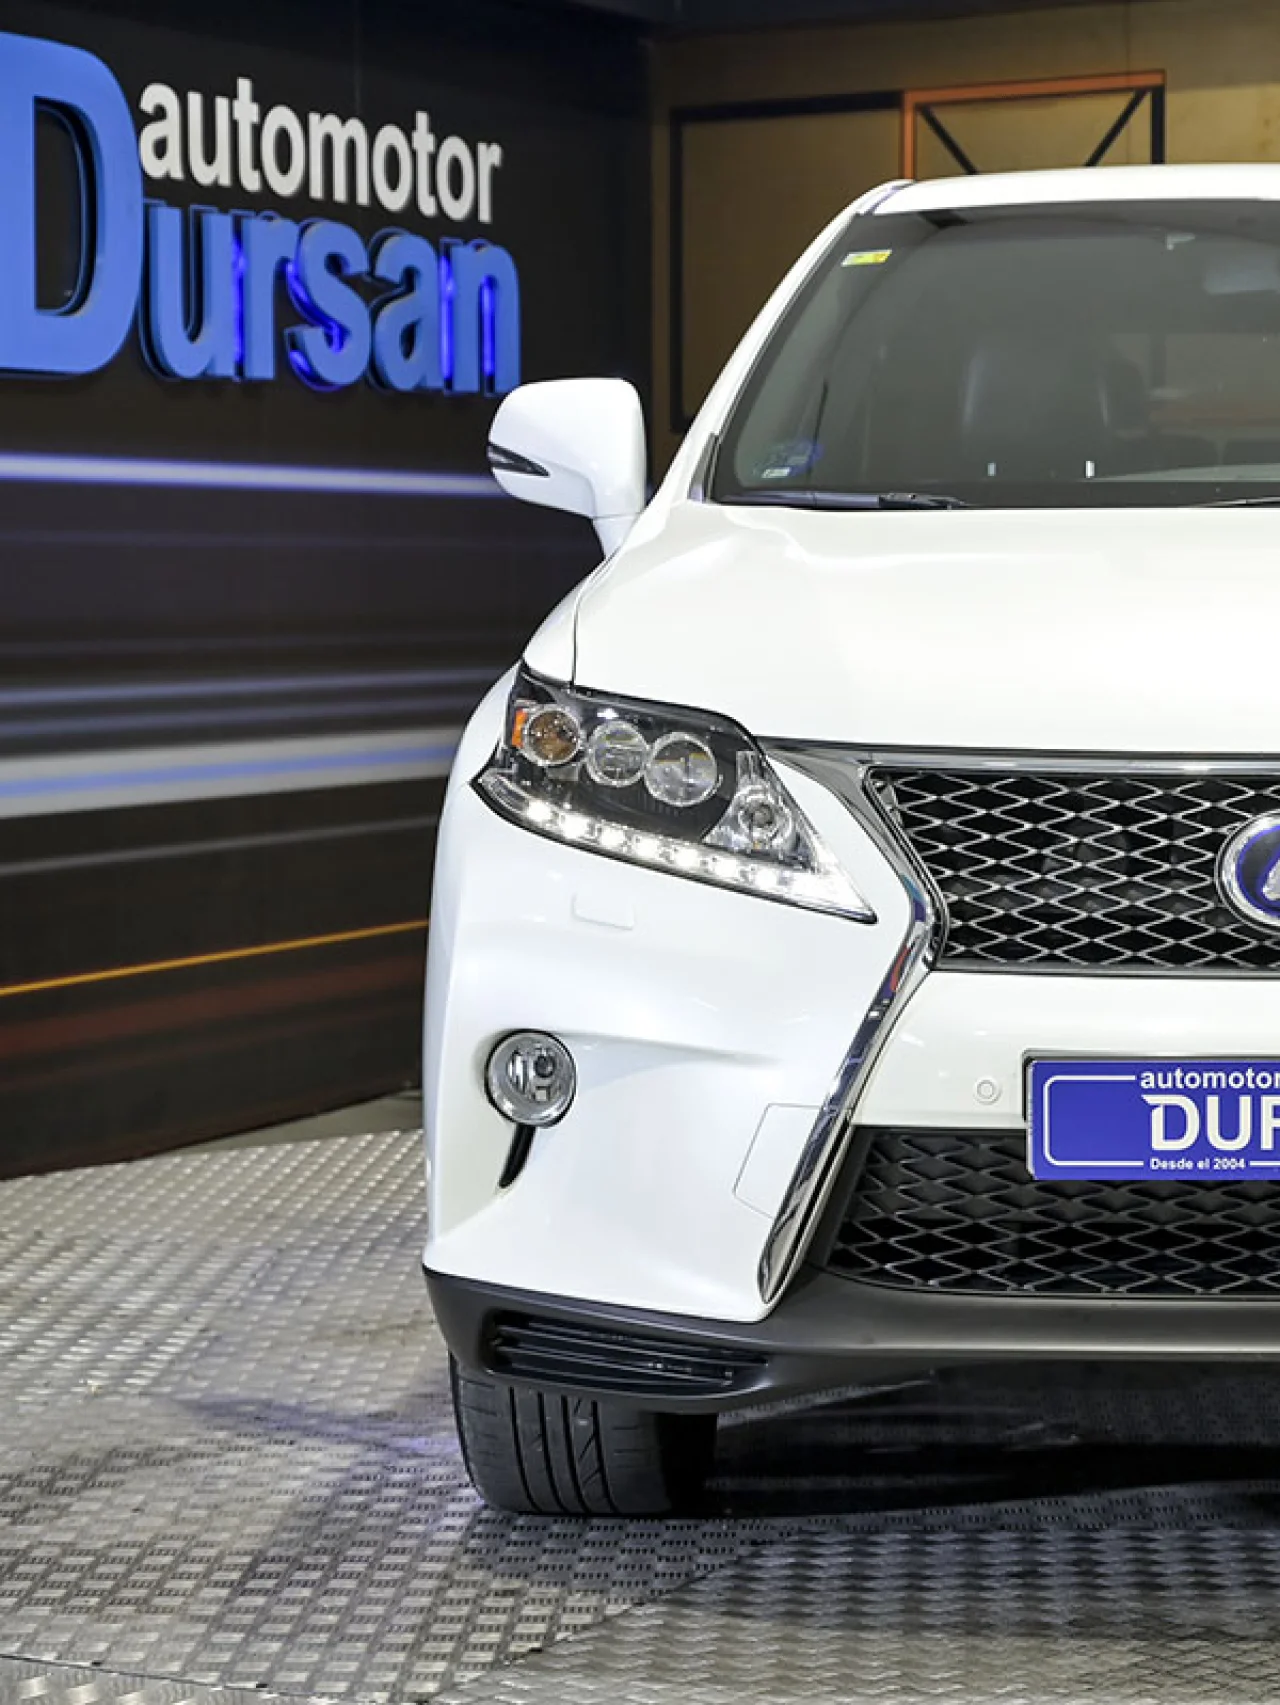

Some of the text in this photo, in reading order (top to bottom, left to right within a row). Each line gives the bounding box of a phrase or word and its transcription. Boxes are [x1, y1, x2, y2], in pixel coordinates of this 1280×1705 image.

[0, 31, 521, 394] Dursan
[138, 76, 502, 223] automotor
[1149, 1157, 1246, 1171] Desde el 2004
